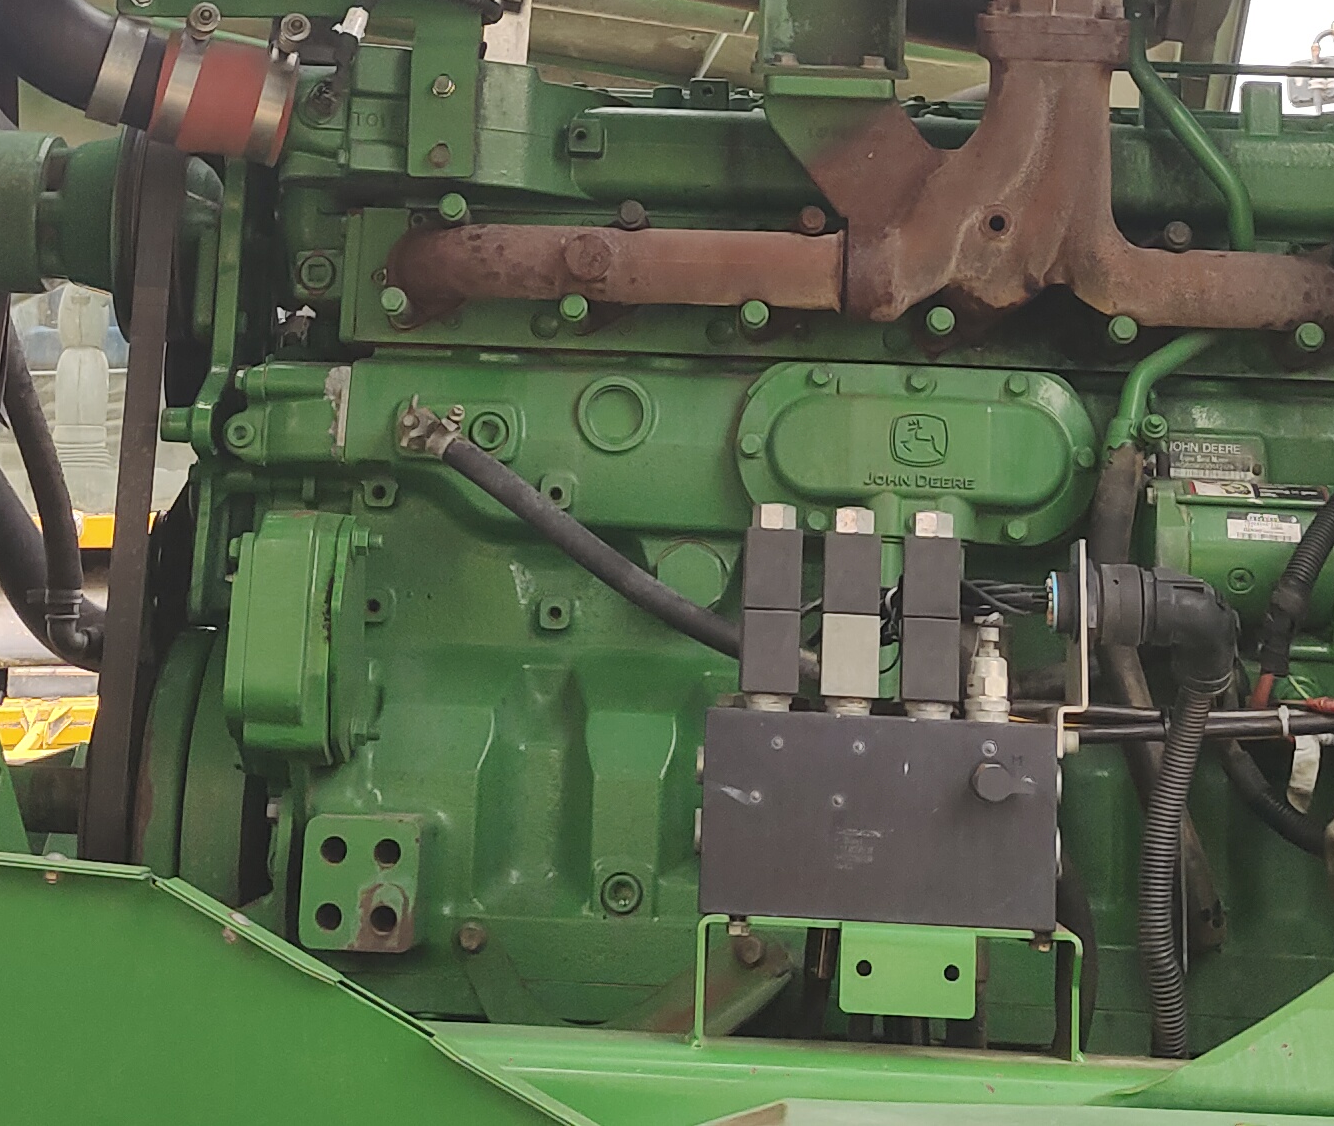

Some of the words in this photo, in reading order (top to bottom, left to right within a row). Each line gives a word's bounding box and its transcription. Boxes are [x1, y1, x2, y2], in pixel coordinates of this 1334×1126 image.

[1169, 441, 1199, 453] JOHN
[1202, 442, 1242, 455] DEERE
[863, 472, 911, 487] JOHN
[914, 474, 976, 490] DEERE
